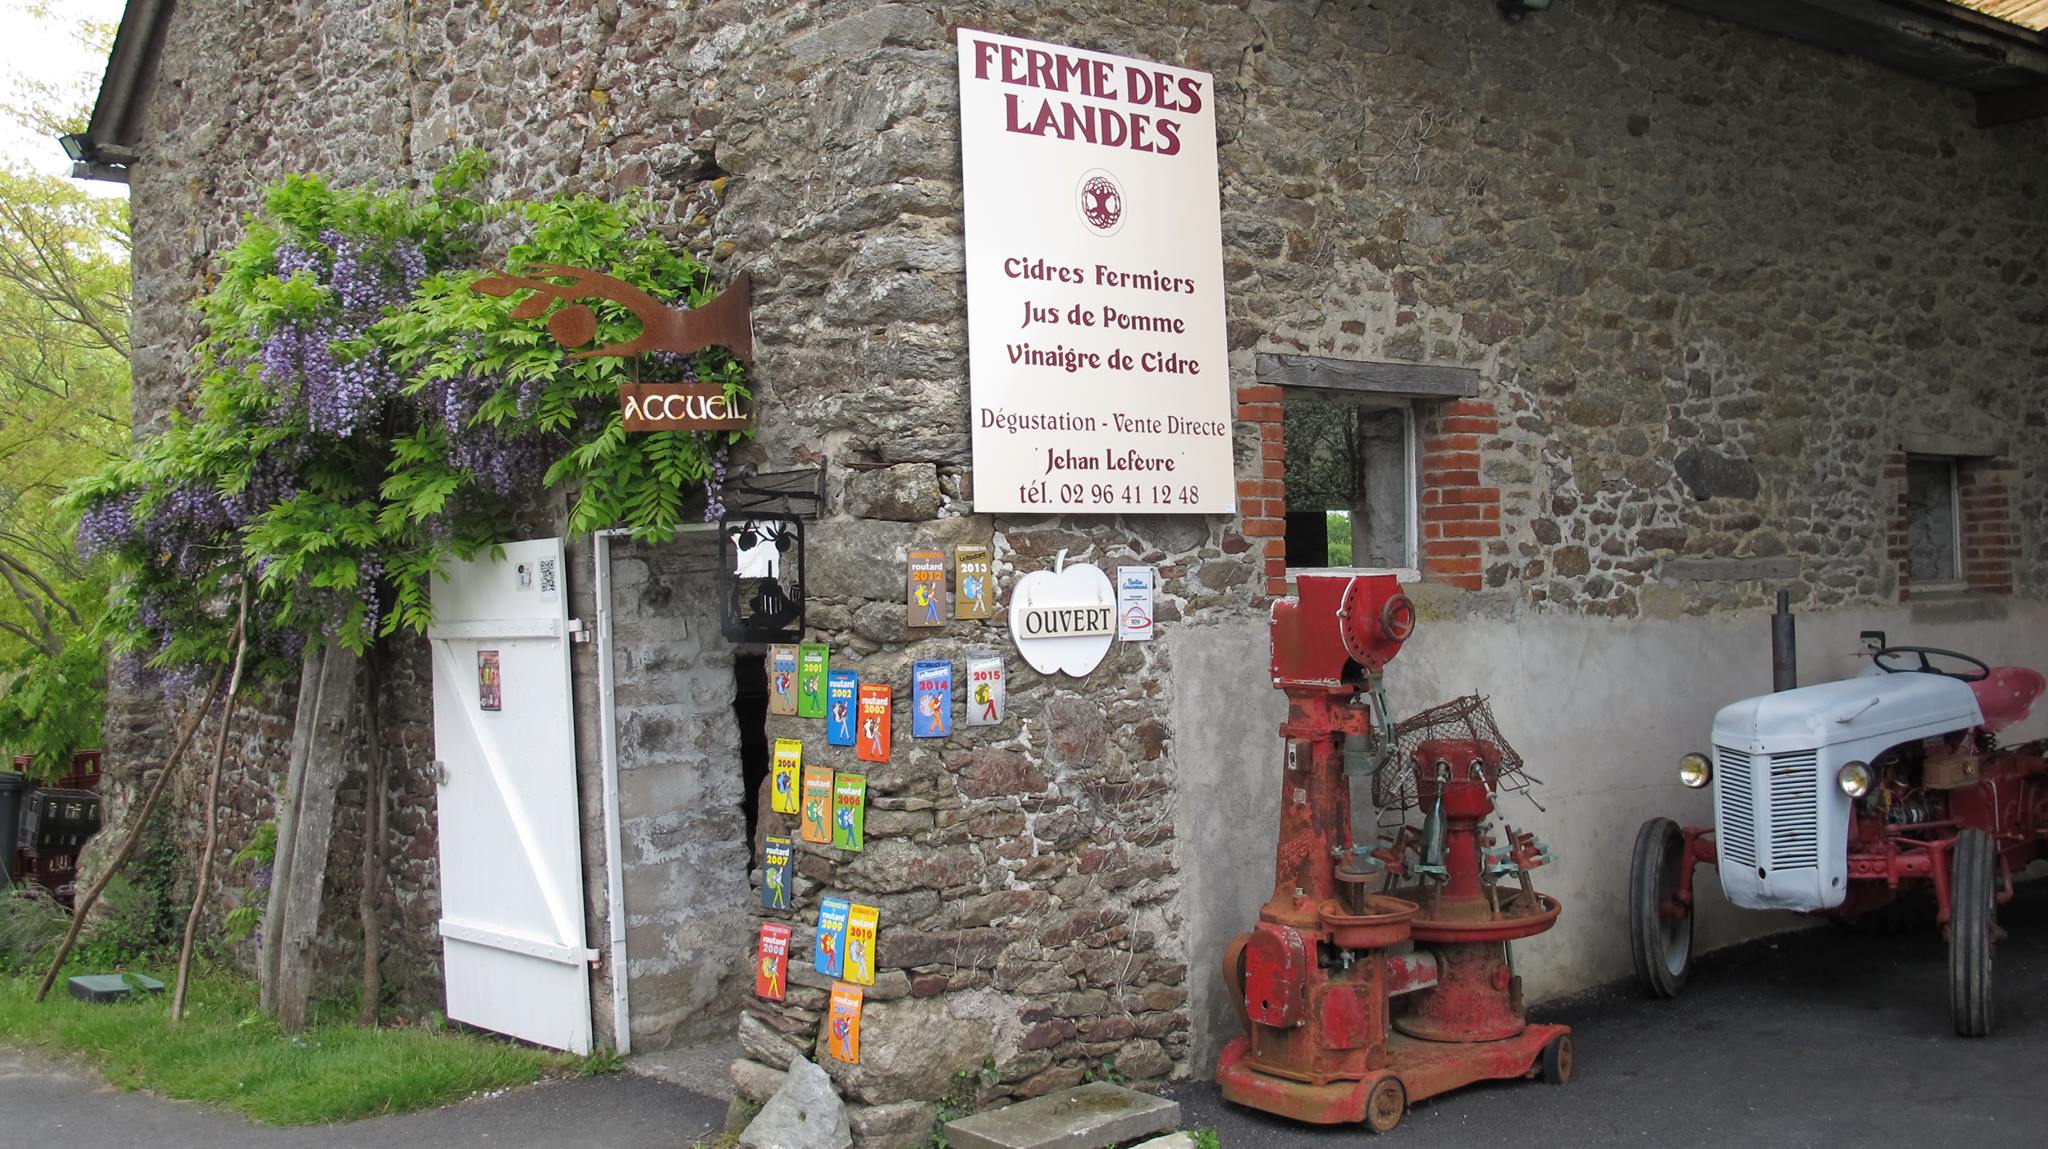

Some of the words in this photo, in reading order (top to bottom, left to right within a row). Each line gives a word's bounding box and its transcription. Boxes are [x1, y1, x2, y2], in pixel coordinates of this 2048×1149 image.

[973, 40, 1117, 100] FERME
[1125, 66, 1203, 114] DES
[1004, 93, 1181, 156] LANDES
[1004, 257, 1084, 284] Cidres
[1095, 264, 1195, 294] Fermiers
[1021, 300, 1060, 329] Jus
[1067, 303, 1096, 327] de
[1103, 305, 1186, 334] Pomme
[1006, 342, 1101, 373] Vinaigre
[1107, 348, 1135, 372] de
[1141, 350, 1200, 375] Cidre
[624, 394, 747, 421] ACCUEIL
[980, 408, 1096, 434] Dégustation
[1113, 413, 1162, 434] Vente
[1168, 415, 1226, 436] Directe
[1045, 448, 1099, 475] Jehan
[1106, 449, 1175, 472] Lefèvre
[1020, 480, 1053, 504] tél.
[1060, 484, 1084, 504] 02
[1092, 484, 1114, 504] 96
[1121, 485, 1141, 504] 41
[1152, 485, 1172, 504] 12
[1178, 485, 1199, 504] 48
[912, 563, 943, 571] routard
[961, 563, 987, 573] 2013
[912, 571, 943, 580] 2012
[1026, 608, 1110, 634] OUVERT
[804, 663, 822, 672] 2001
[974, 671, 1001, 680] 2015
[830, 680, 854, 688] routard
[919, 681, 948, 690] 2014
[832, 689, 852, 698] 2002
[861, 696, 888, 705] routard
[864, 705, 885, 714] 2003
[777, 759, 796, 768] 2004
[838, 795, 861, 806] 2006
[766, 847, 790, 856] routard
[767, 855, 788, 865] 2007
[822, 912, 845, 922] routard
[822, 919, 843, 932] 2009
[850, 926, 873, 940] 2010
[763, 936, 786, 946] routard
[763, 944, 785, 956] 2008
